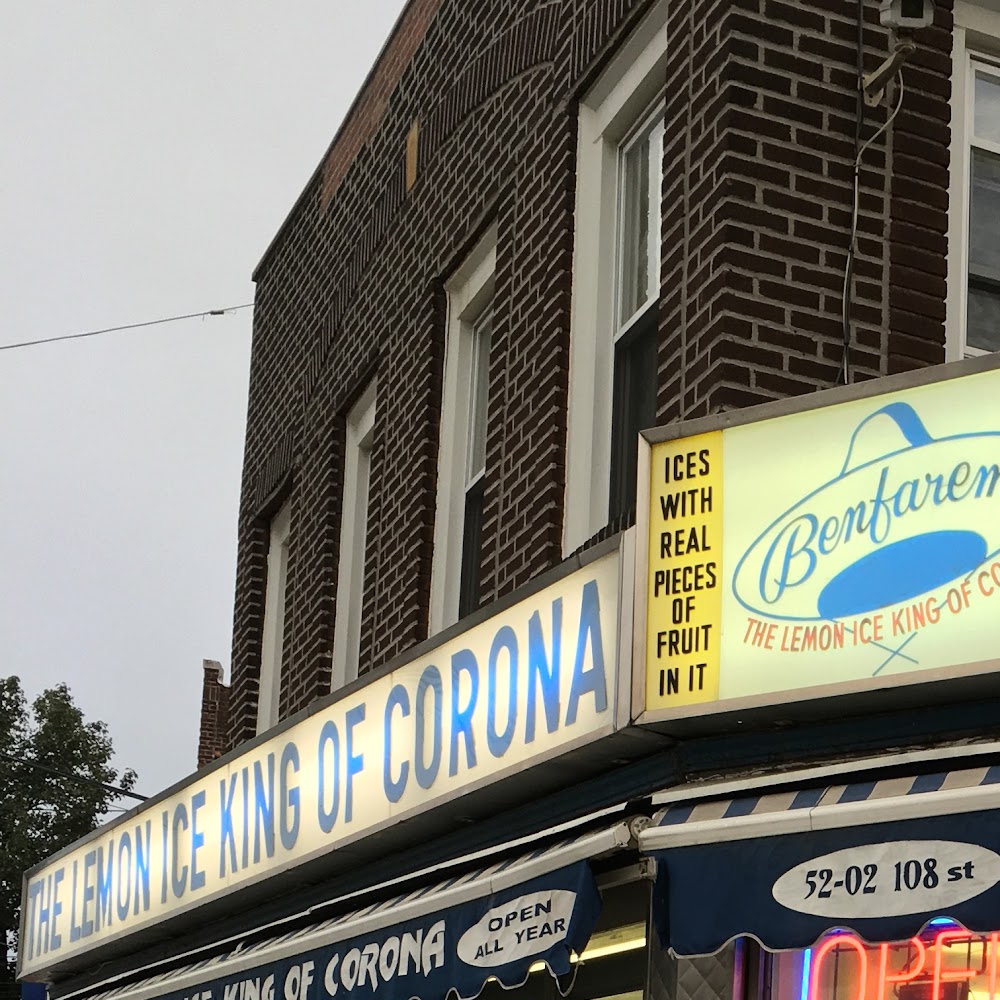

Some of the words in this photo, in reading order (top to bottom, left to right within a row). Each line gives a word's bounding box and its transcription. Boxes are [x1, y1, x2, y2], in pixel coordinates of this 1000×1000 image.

[665, 450, 711, 484] ICES
[660, 487, 713, 521] WITH
[660, 528, 712, 559] REAL
[654, 562, 717, 597] PIECES
[672, 597, 696, 625] OF
[743, 617, 779, 651] THE
[781, 620, 845, 653] LEMON
[853, 611, 884, 646] ICE
[891, 593, 941, 637] KING
[948, 575, 973, 615] OF
[656, 624, 713, 658] FRUIT
[659, 669, 681, 697] IN
[689, 663, 704, 691] IT
[27, 879, 62, 961] THE
[69, 828, 150, 943] LEMON
[161, 790, 206, 904] ICE
[219, 742, 300, 879] KING
[318, 703, 366, 834] OF
[383, 580, 608, 803] CORONA
[804, 864, 878, 900] 52-02
[894, 858, 939, 892] 108
[947, 861, 975, 882] st
[487, 901, 552, 932] OPEN
[475, 938, 503, 960] ALL
[515, 918, 566, 945] YEAR
[324, 920, 445, 997] CORONA
